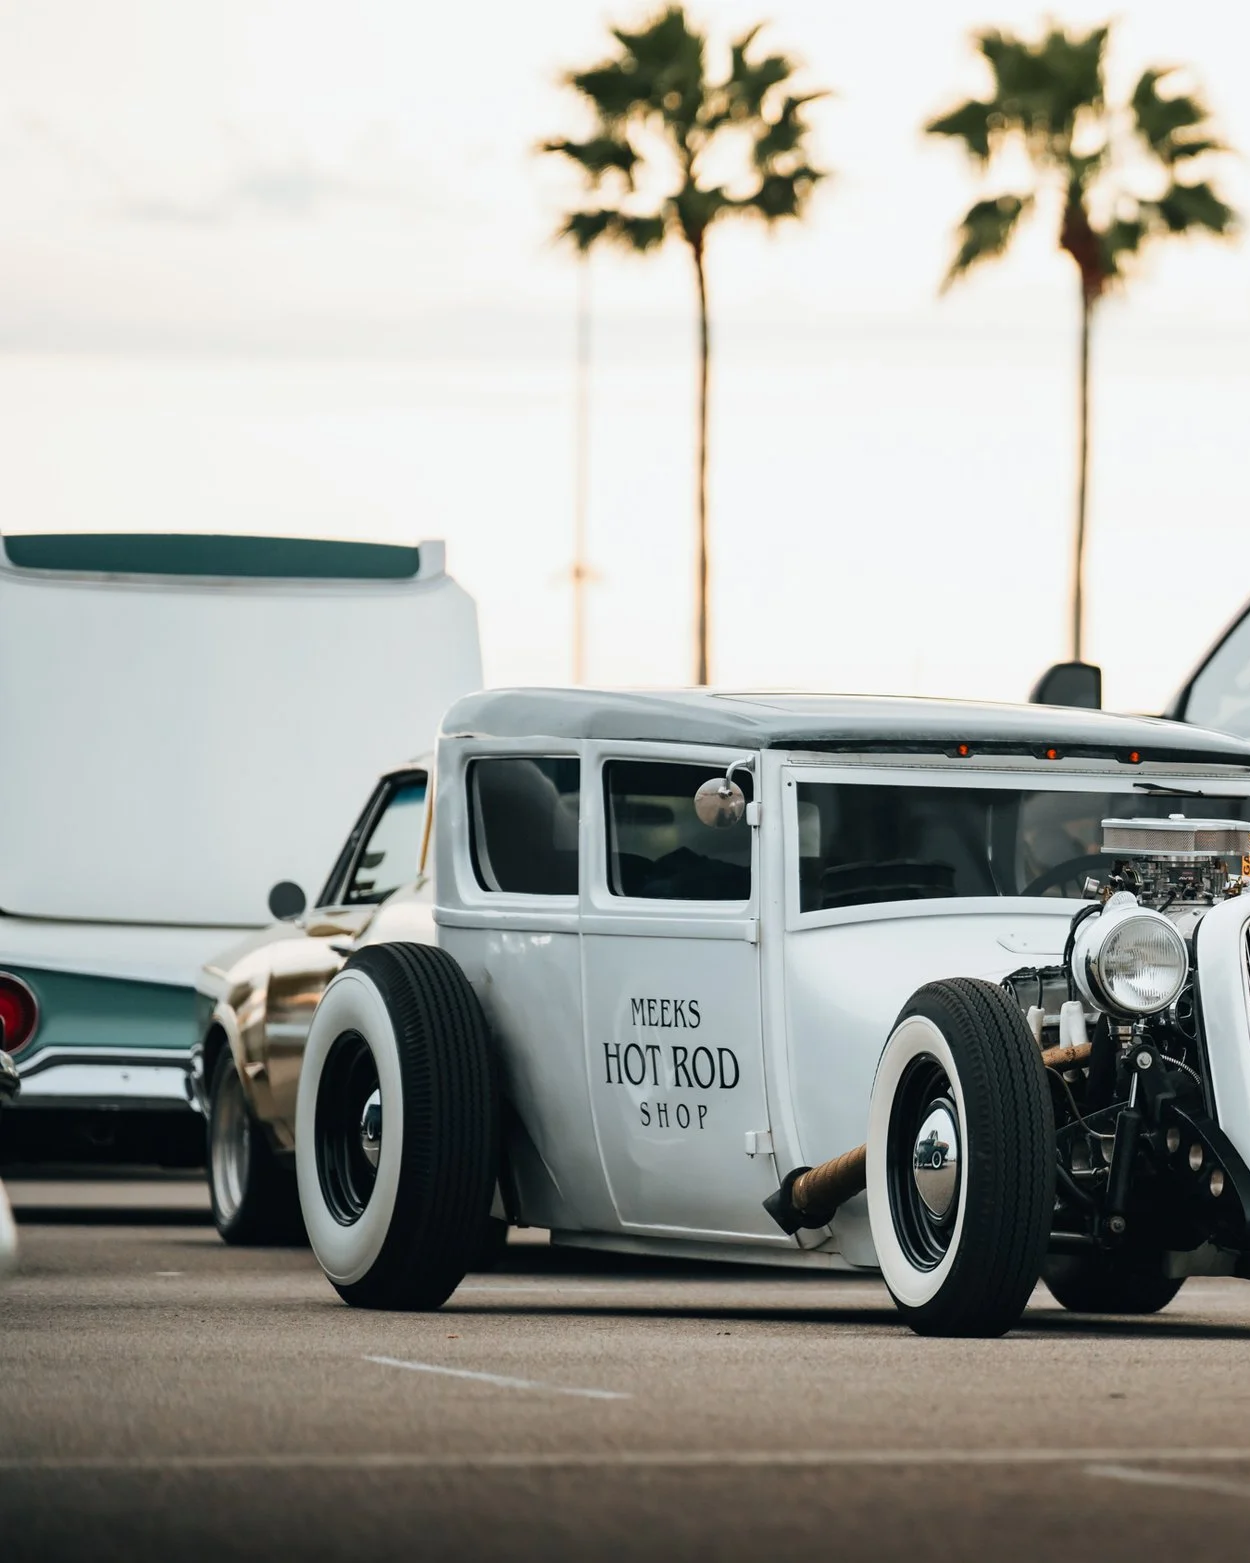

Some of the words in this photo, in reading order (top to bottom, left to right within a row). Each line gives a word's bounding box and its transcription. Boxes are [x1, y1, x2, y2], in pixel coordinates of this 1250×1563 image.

[630, 998, 701, 1029] MEEKS
[602, 1042, 662, 1086] HOT
[671, 1045, 740, 1089] ROD
[639, 1101, 708, 1130] SHOP
